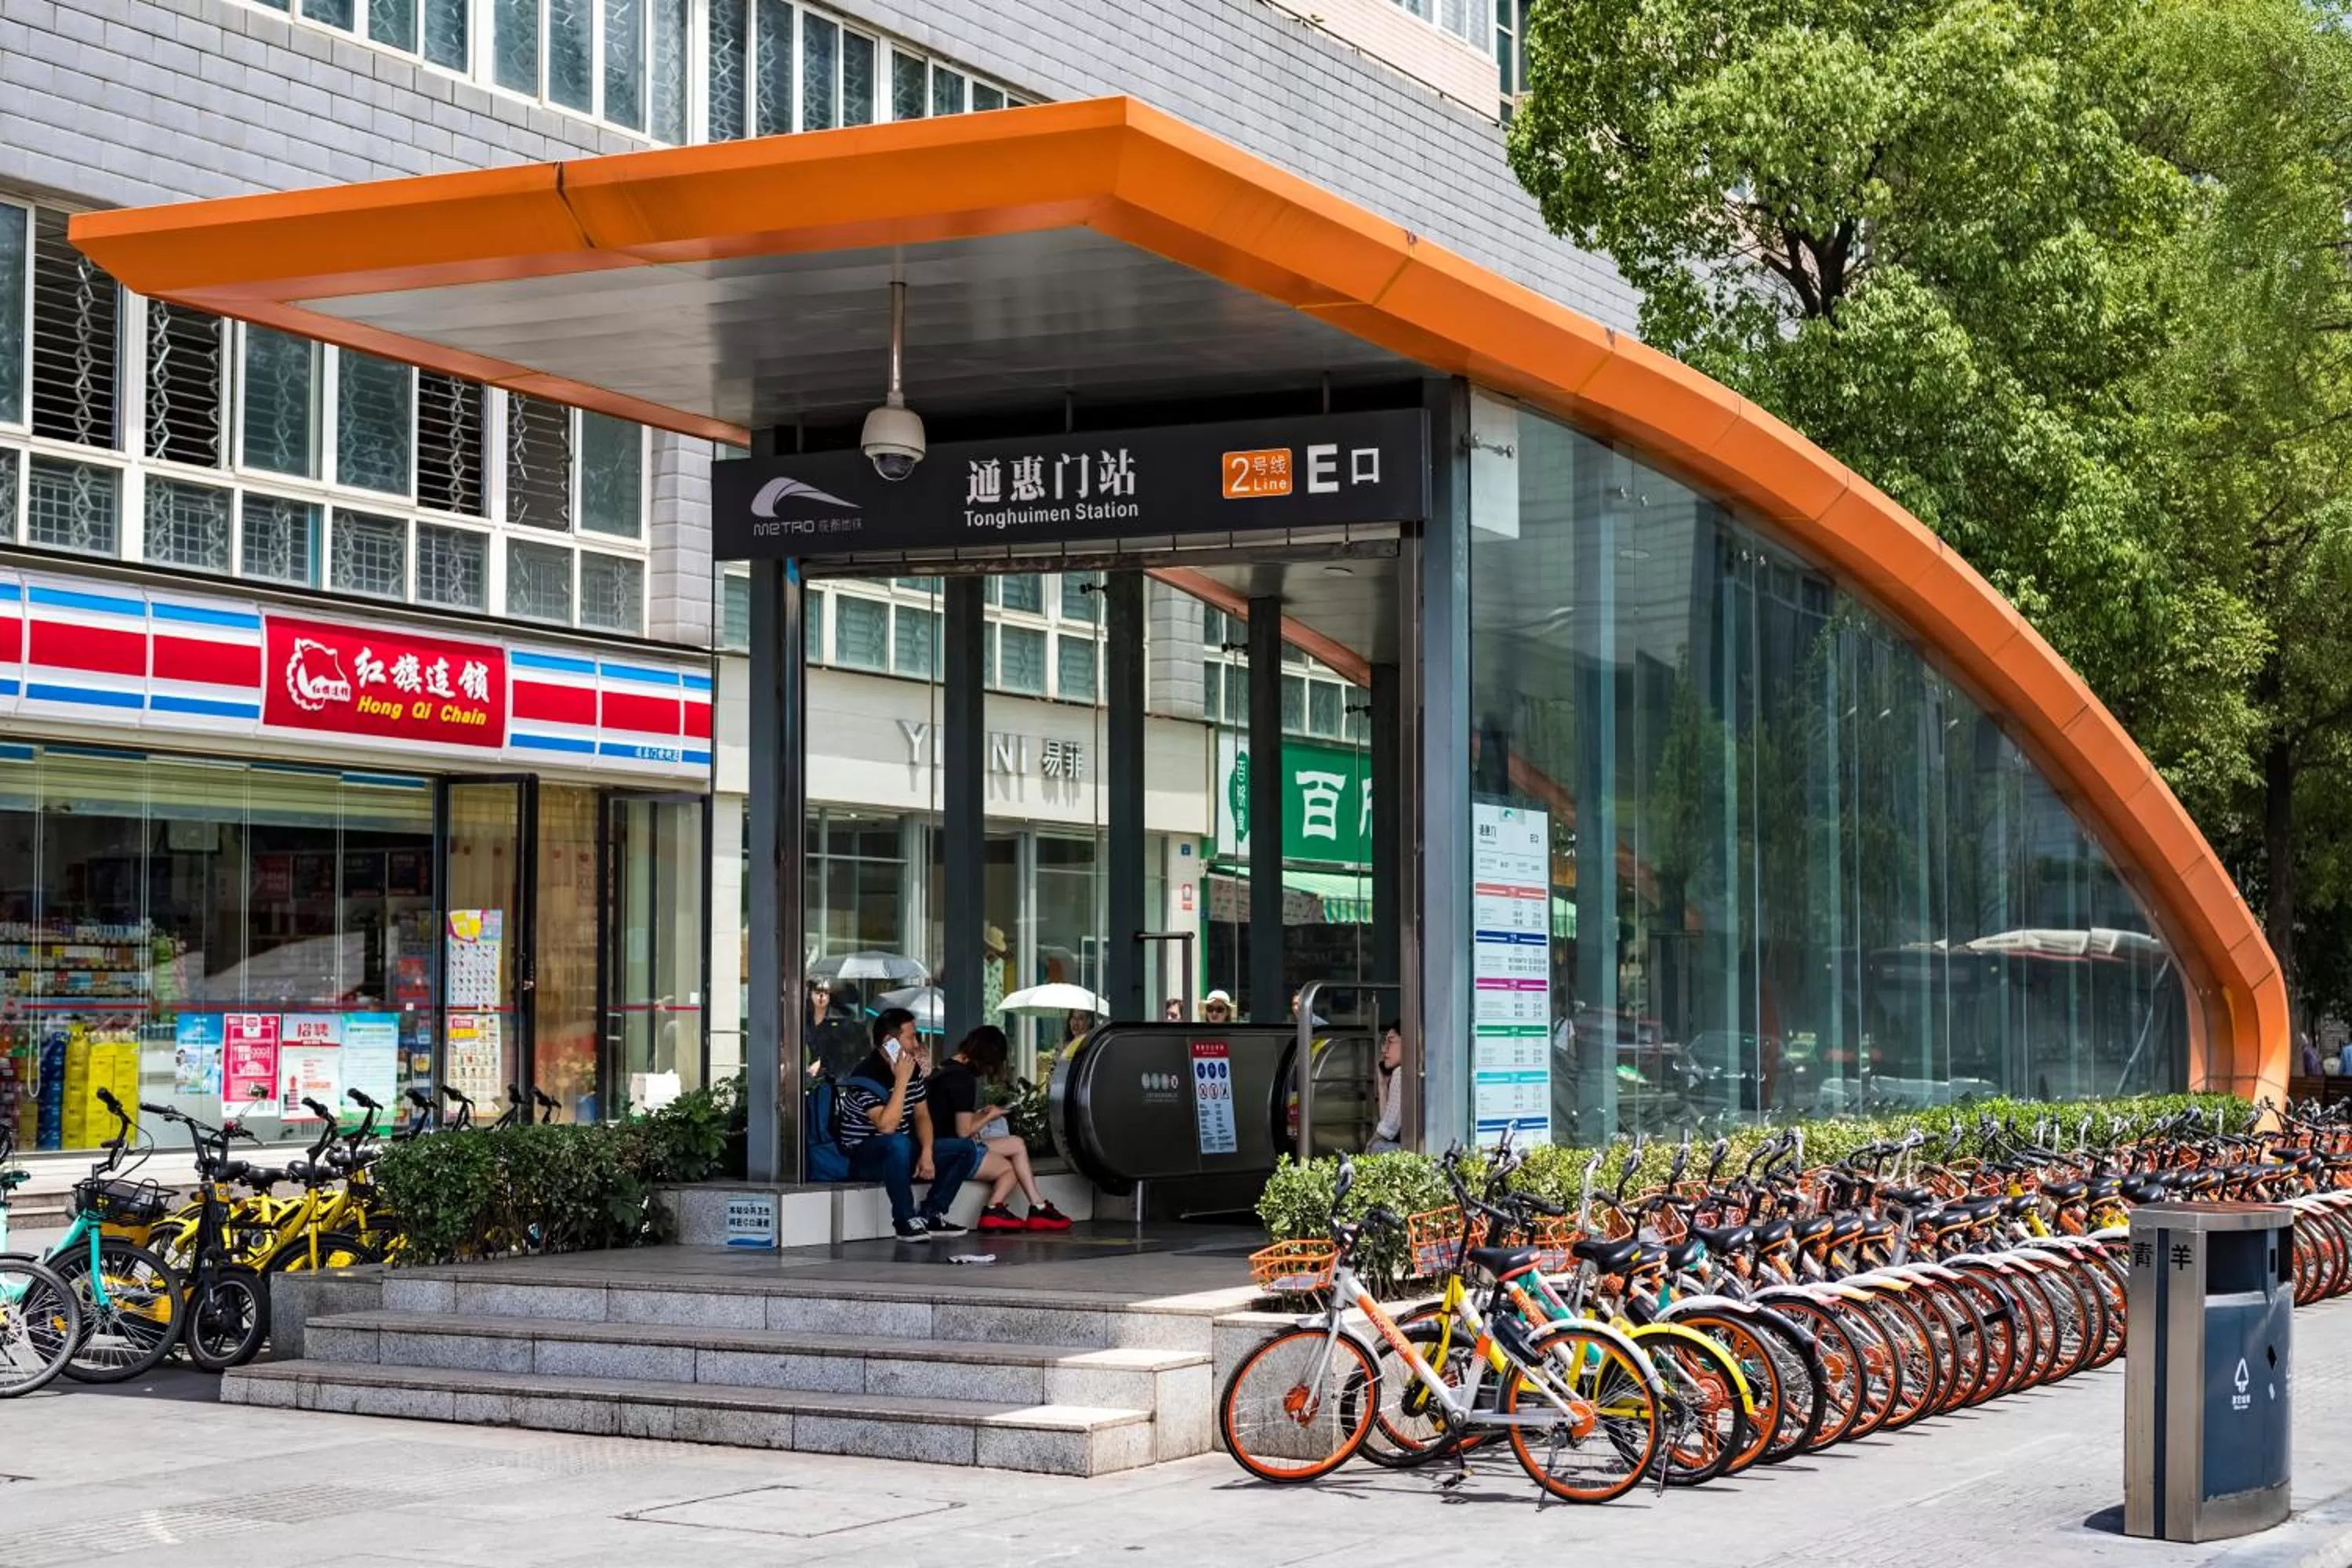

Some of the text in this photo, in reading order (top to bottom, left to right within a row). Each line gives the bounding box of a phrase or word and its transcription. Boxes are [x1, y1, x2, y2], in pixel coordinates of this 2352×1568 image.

[966, 448, 1136, 505] 通惠门站
[1254, 477, 1287, 491] Line
[753, 520, 815, 536] METRO
[964, 501, 1139, 529] Tonghuimen Station
[354, 646, 490, 703] 红旗连锁
[357, 695, 488, 726] Hong Qi Chain
